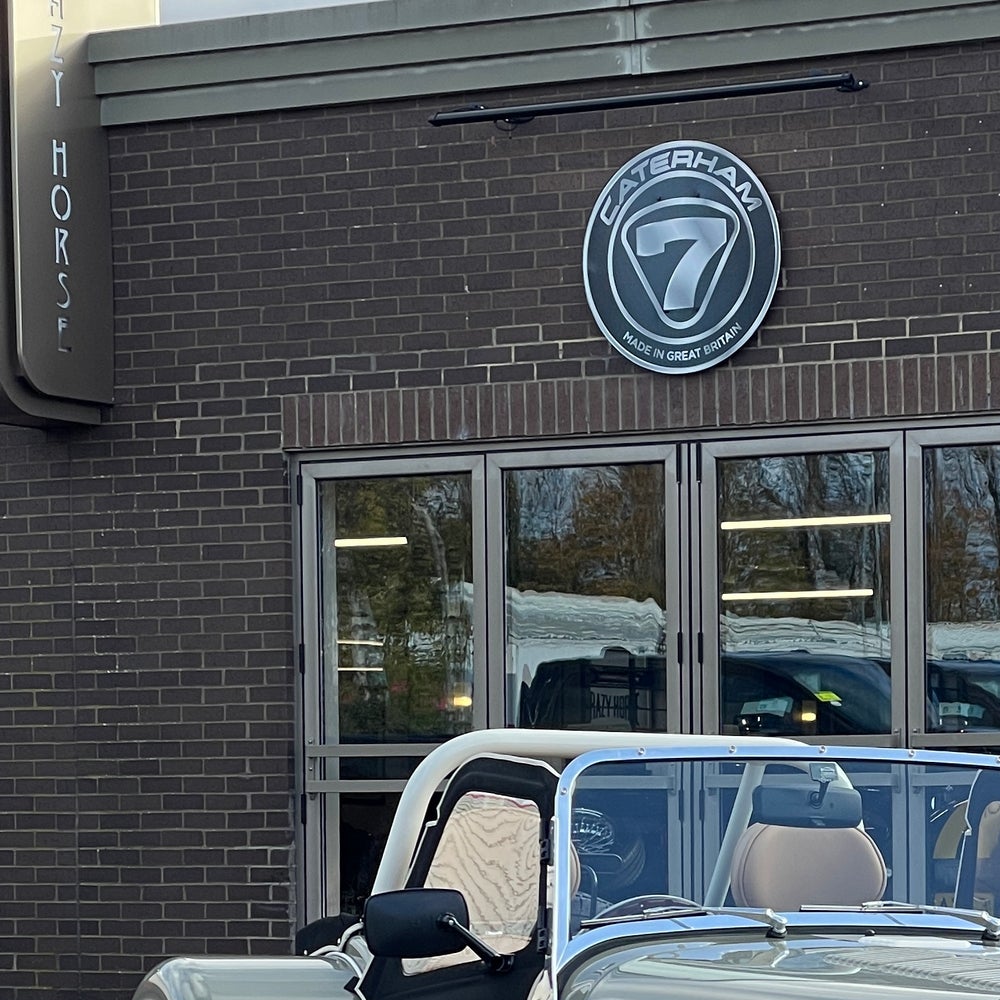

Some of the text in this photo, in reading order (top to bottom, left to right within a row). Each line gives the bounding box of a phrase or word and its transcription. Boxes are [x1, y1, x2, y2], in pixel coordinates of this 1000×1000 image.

[600, 149, 763, 226] CATERHAM
[51, 138, 72, 353] HORSE
[636, 216, 727, 311] 7
[622, 321, 743, 361] MADE IN GREAT BRITAIN
